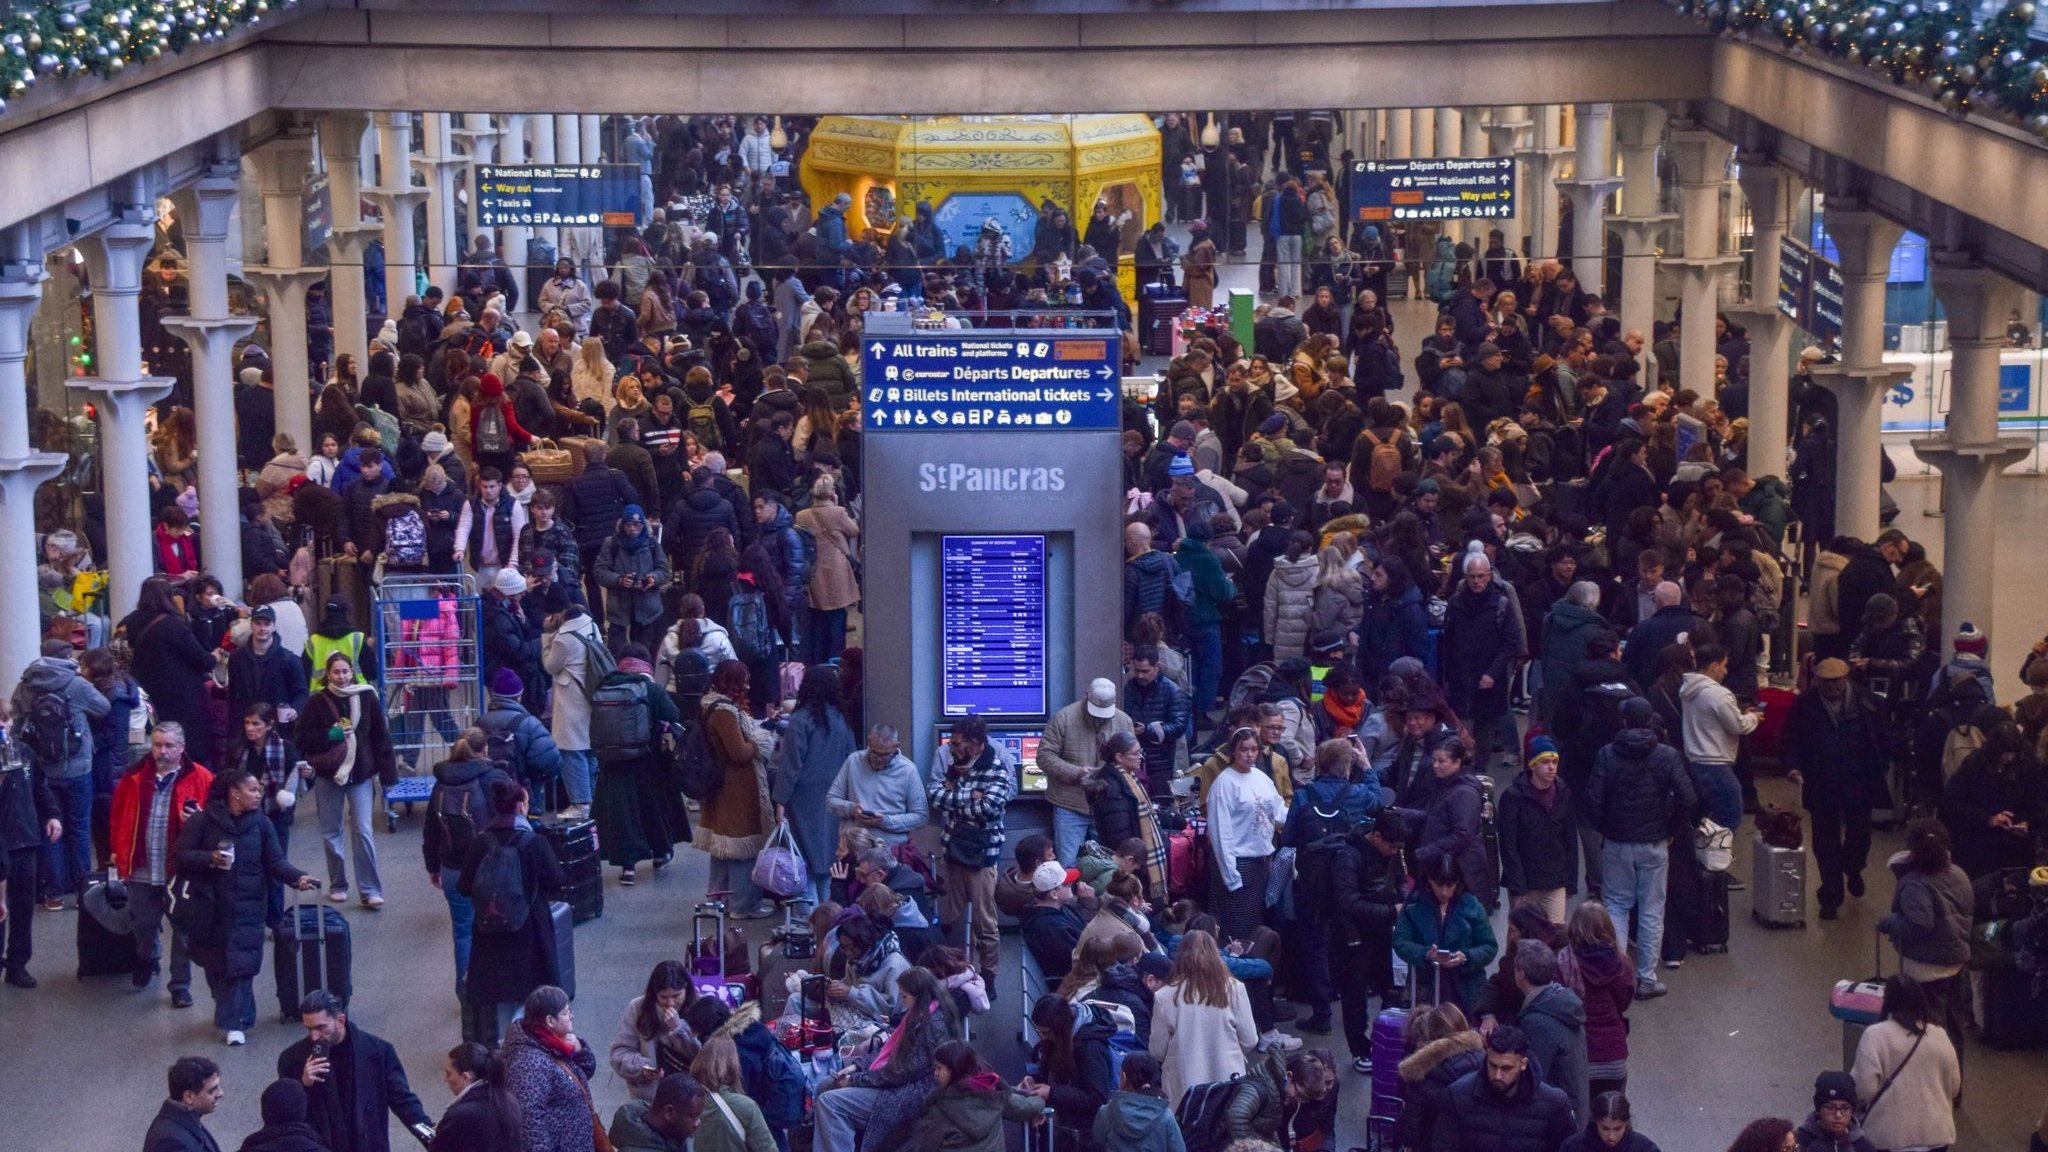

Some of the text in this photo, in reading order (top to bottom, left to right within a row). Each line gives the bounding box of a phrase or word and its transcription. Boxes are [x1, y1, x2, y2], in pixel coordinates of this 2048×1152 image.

[1410, 162, 1445, 172] Départs
[1446, 160, 1496, 170] Departures
[496, 168, 552, 178] National Rail
[1439, 176, 1496, 185] National Rail
[496, 184, 515, 194] Way
[1461, 192, 1497, 201] Way out
[497, 199, 520, 207] Taxis
[893, 344, 957, 357] All trains
[954, 366, 1008, 382] Départs
[1012, 366, 1090, 382] Departures
[904, 388, 1090, 402] Billets International tickets
